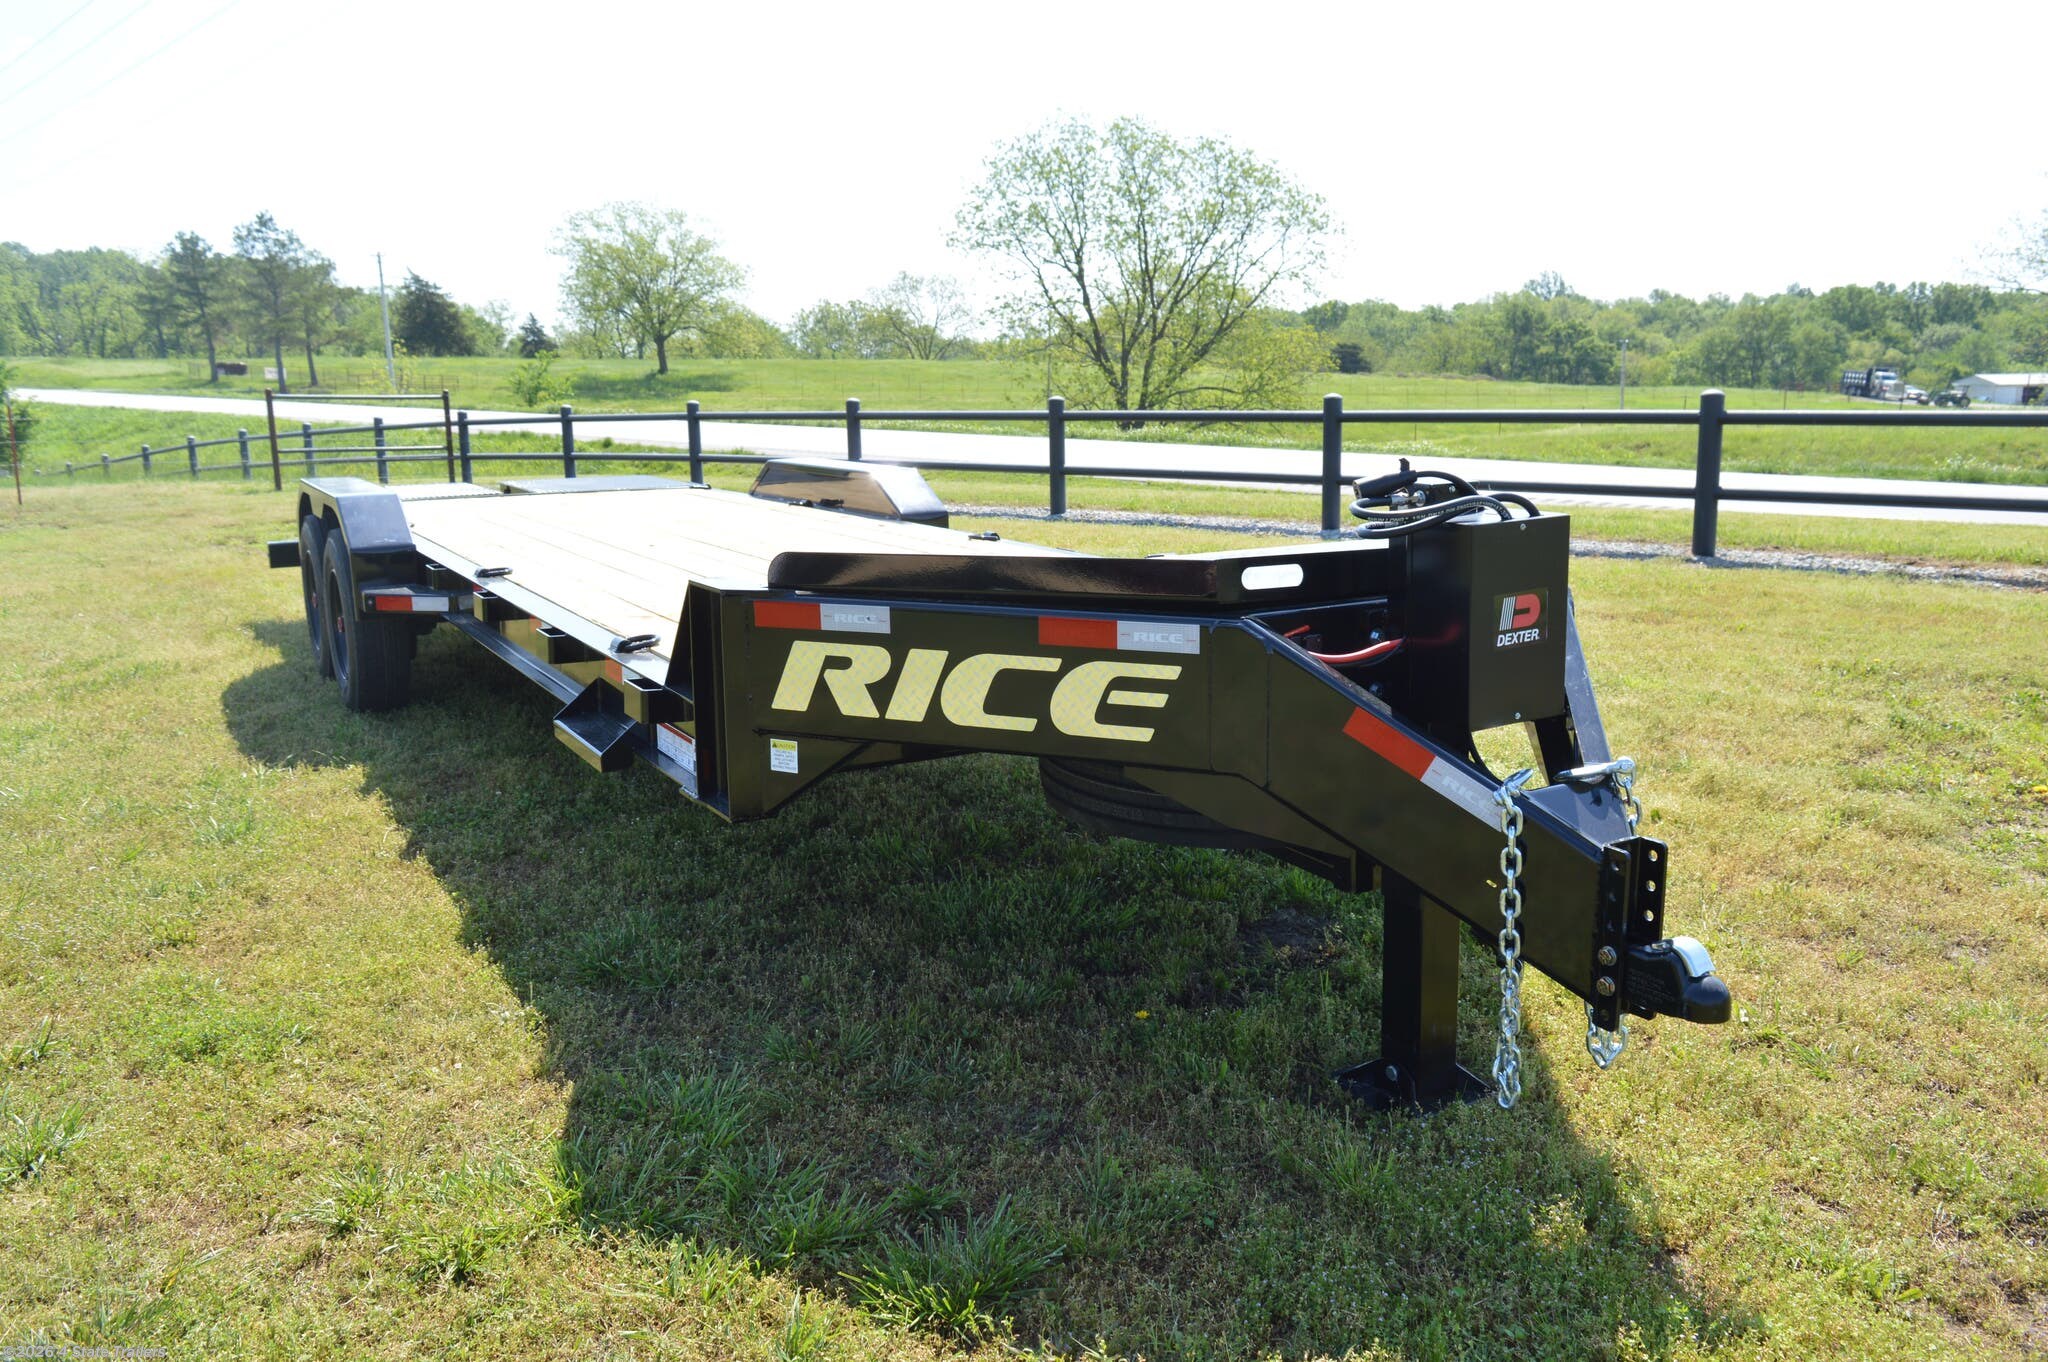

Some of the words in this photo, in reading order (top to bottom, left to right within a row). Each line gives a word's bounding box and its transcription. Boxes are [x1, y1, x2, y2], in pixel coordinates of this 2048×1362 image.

[833, 613, 880, 625] RICE
[1132, 631, 1184, 644] RICE
[1496, 628, 1540, 648] DEXTER
[770, 639, 1183, 743] RICE
